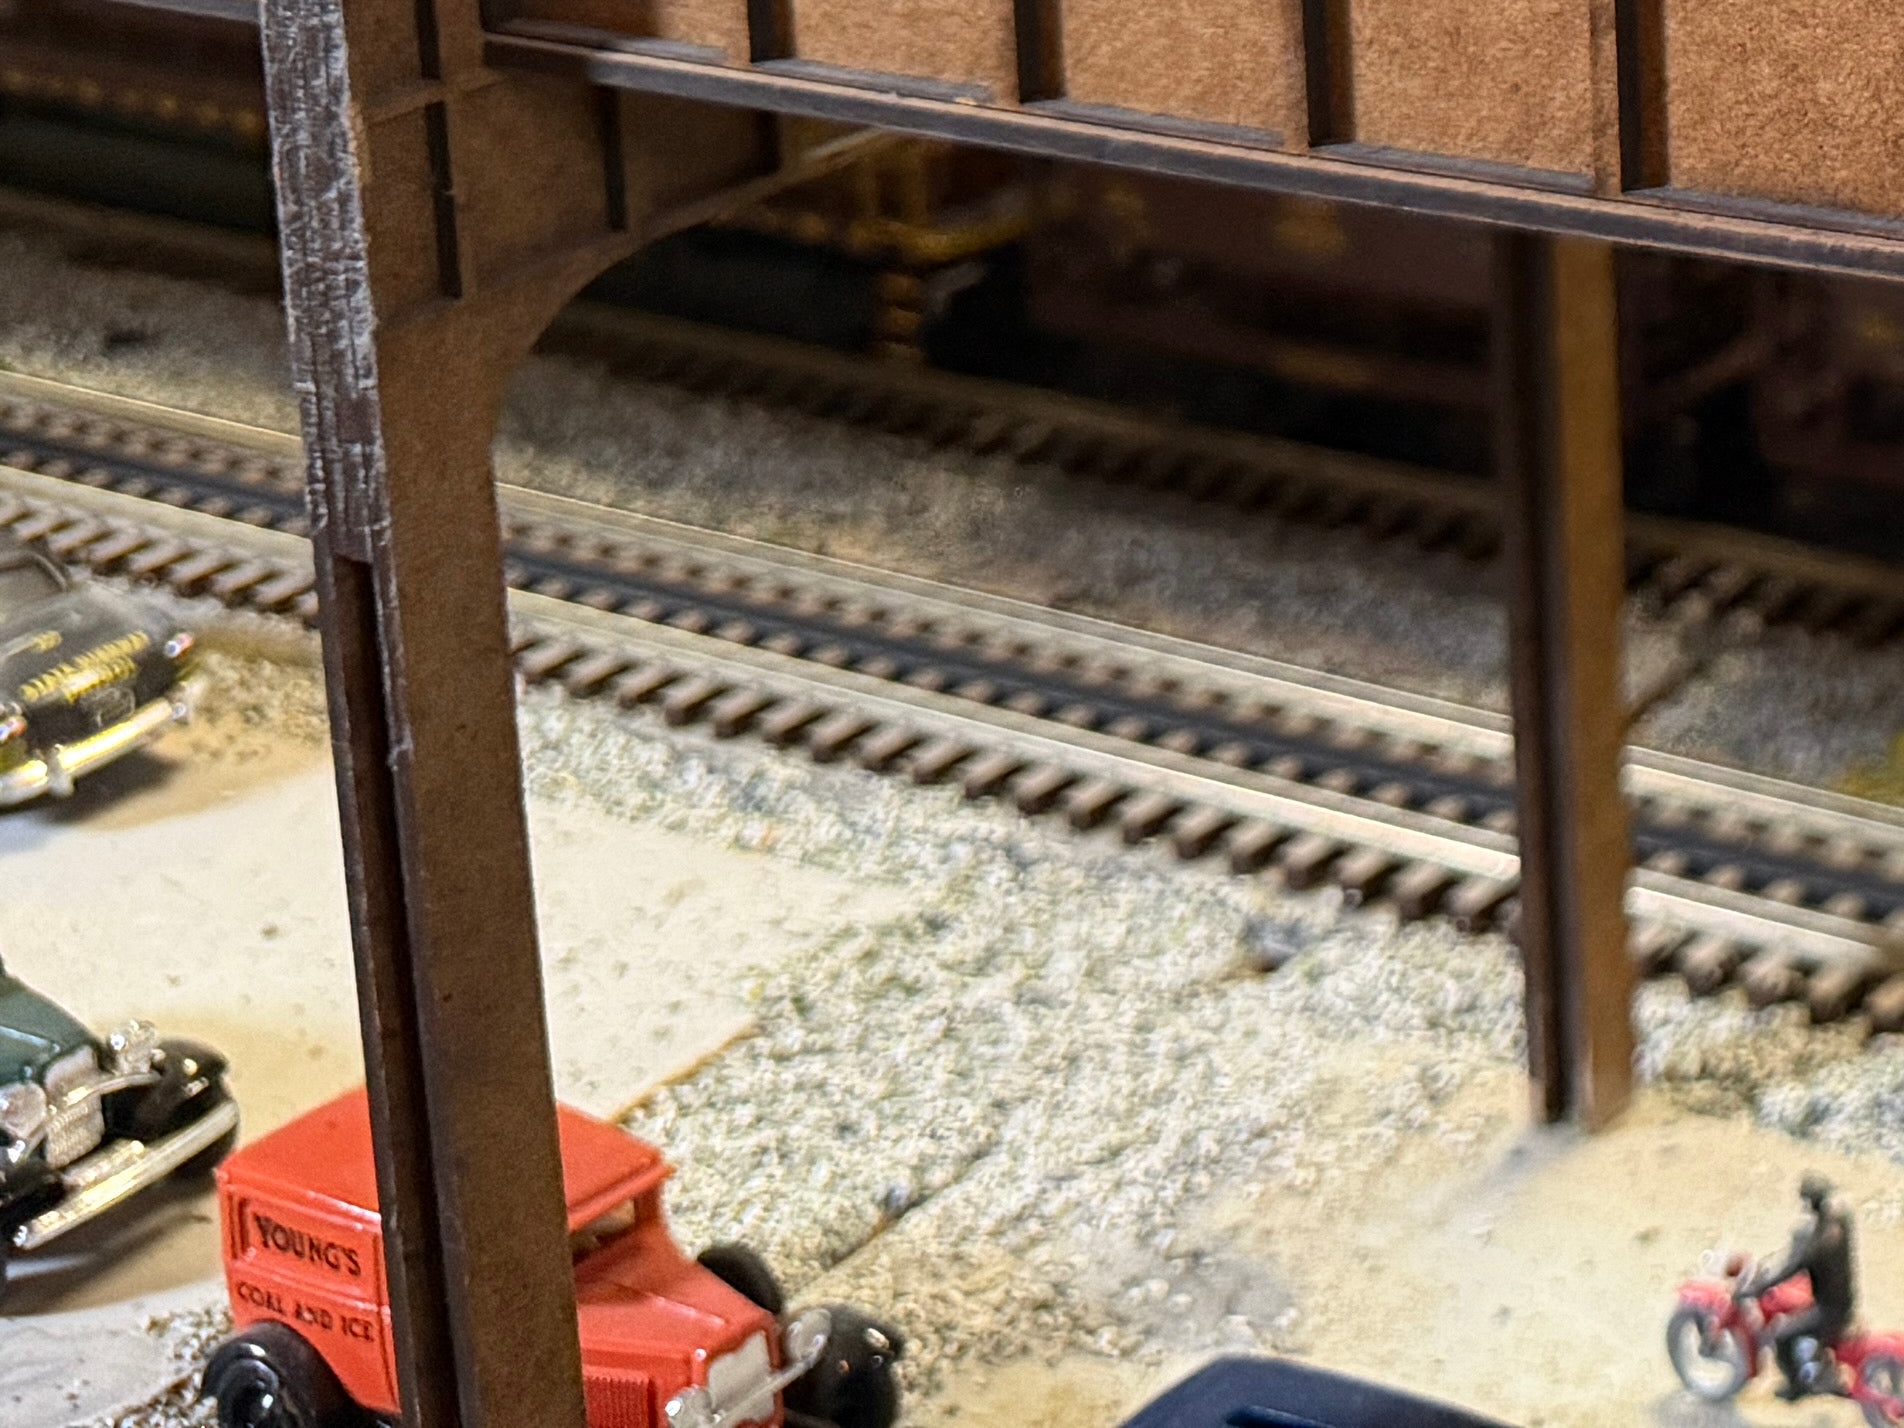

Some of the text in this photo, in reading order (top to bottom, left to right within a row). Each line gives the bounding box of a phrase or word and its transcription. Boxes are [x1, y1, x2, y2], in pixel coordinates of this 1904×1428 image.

[253, 1212, 362, 1277] YOUNG'S
[236, 1281, 376, 1343] COAL AND ICE
